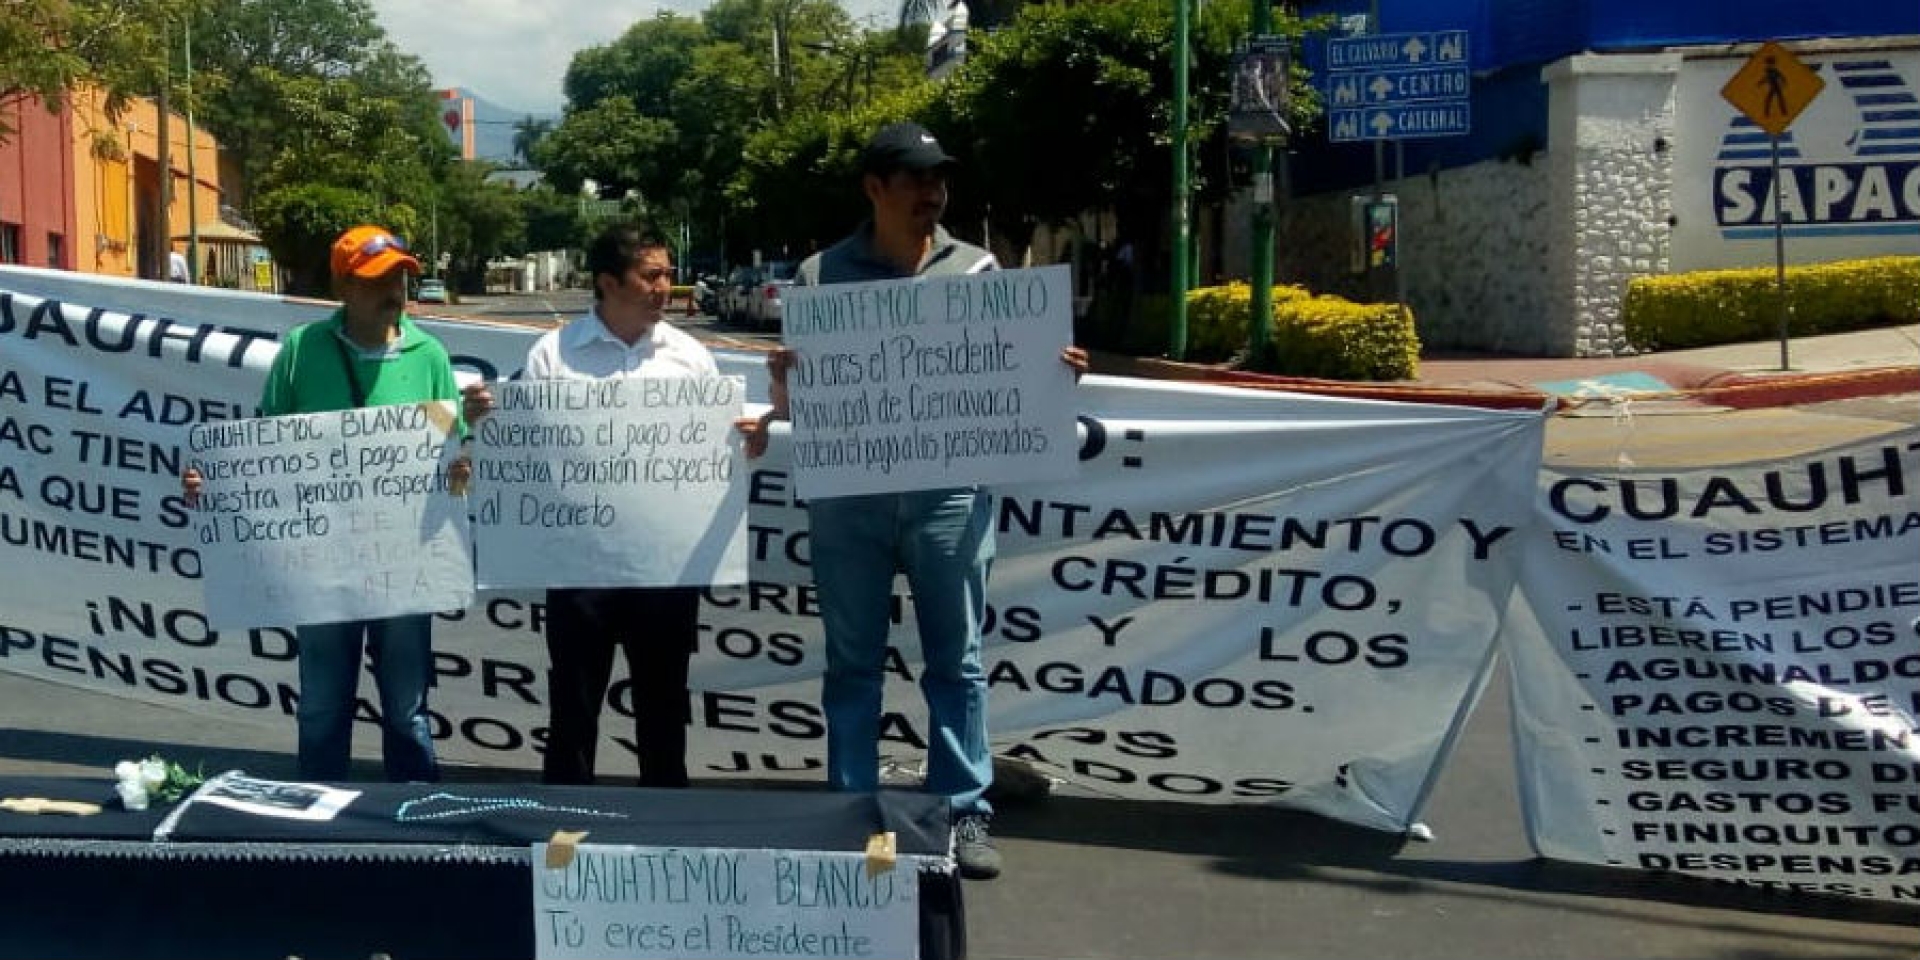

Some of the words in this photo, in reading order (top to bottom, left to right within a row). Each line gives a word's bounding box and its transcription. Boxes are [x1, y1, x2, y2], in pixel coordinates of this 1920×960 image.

[1399, 72, 1465, 95] CENTRO
[1399, 110, 1465, 131] CATEDRAL
[946, 275, 1049, 323] BLANCO
[0, 293, 278, 368] AUHT
[869, 341, 888, 383] el
[891, 326, 1020, 380] Presidente
[341, 405, 427, 439] BLANCO
[878, 388, 902, 425] de
[596, 418, 613, 447] el
[626, 422, 671, 458] pago
[680, 414, 707, 445] de
[44, 375, 103, 415] EL
[1000, 497, 1436, 558] NTAMIENTO
[1458, 518, 1515, 561] Y
[329, 443, 349, 470] el
[359, 444, 408, 475] pago
[479, 454, 551, 483] nuestra
[1549, 442, 1920, 524] CUAUH
[234, 507, 330, 543] Decreto
[481, 491, 500, 525] al
[520, 491, 615, 528] Decreto
[1553, 530, 1612, 553] EN
[1627, 537, 1688, 560] EL
[1705, 512, 1920, 556] SISTEMA
[40, 475, 141, 521] QUE
[1087, 614, 1134, 647] Y
[1258, 625, 1409, 668] LOS
[1051, 556, 1402, 614] CRÉDITO,
[1730, 581, 1920, 622] PENDIE
[1571, 623, 1774, 654] LIBEREN
[1793, 620, 1896, 654] LOS
[986, 660, 1315, 713] AGADOS.
[1605, 655, 1920, 685] AGUINALDO
[1612, 690, 1797, 717] PAGOS
[1818, 694, 1891, 718] DE
[1621, 758, 1851, 782] SEGURO
[1627, 791, 1852, 814] GASTOS
[1632, 822, 1920, 847] FINIQUITO
[1638, 852, 1920, 876] DESPENSA
[544, 909, 586, 949] Tú
[606, 923, 675, 950] eres
[684, 914, 709, 952] el
[725, 913, 872, 957] Presidente
